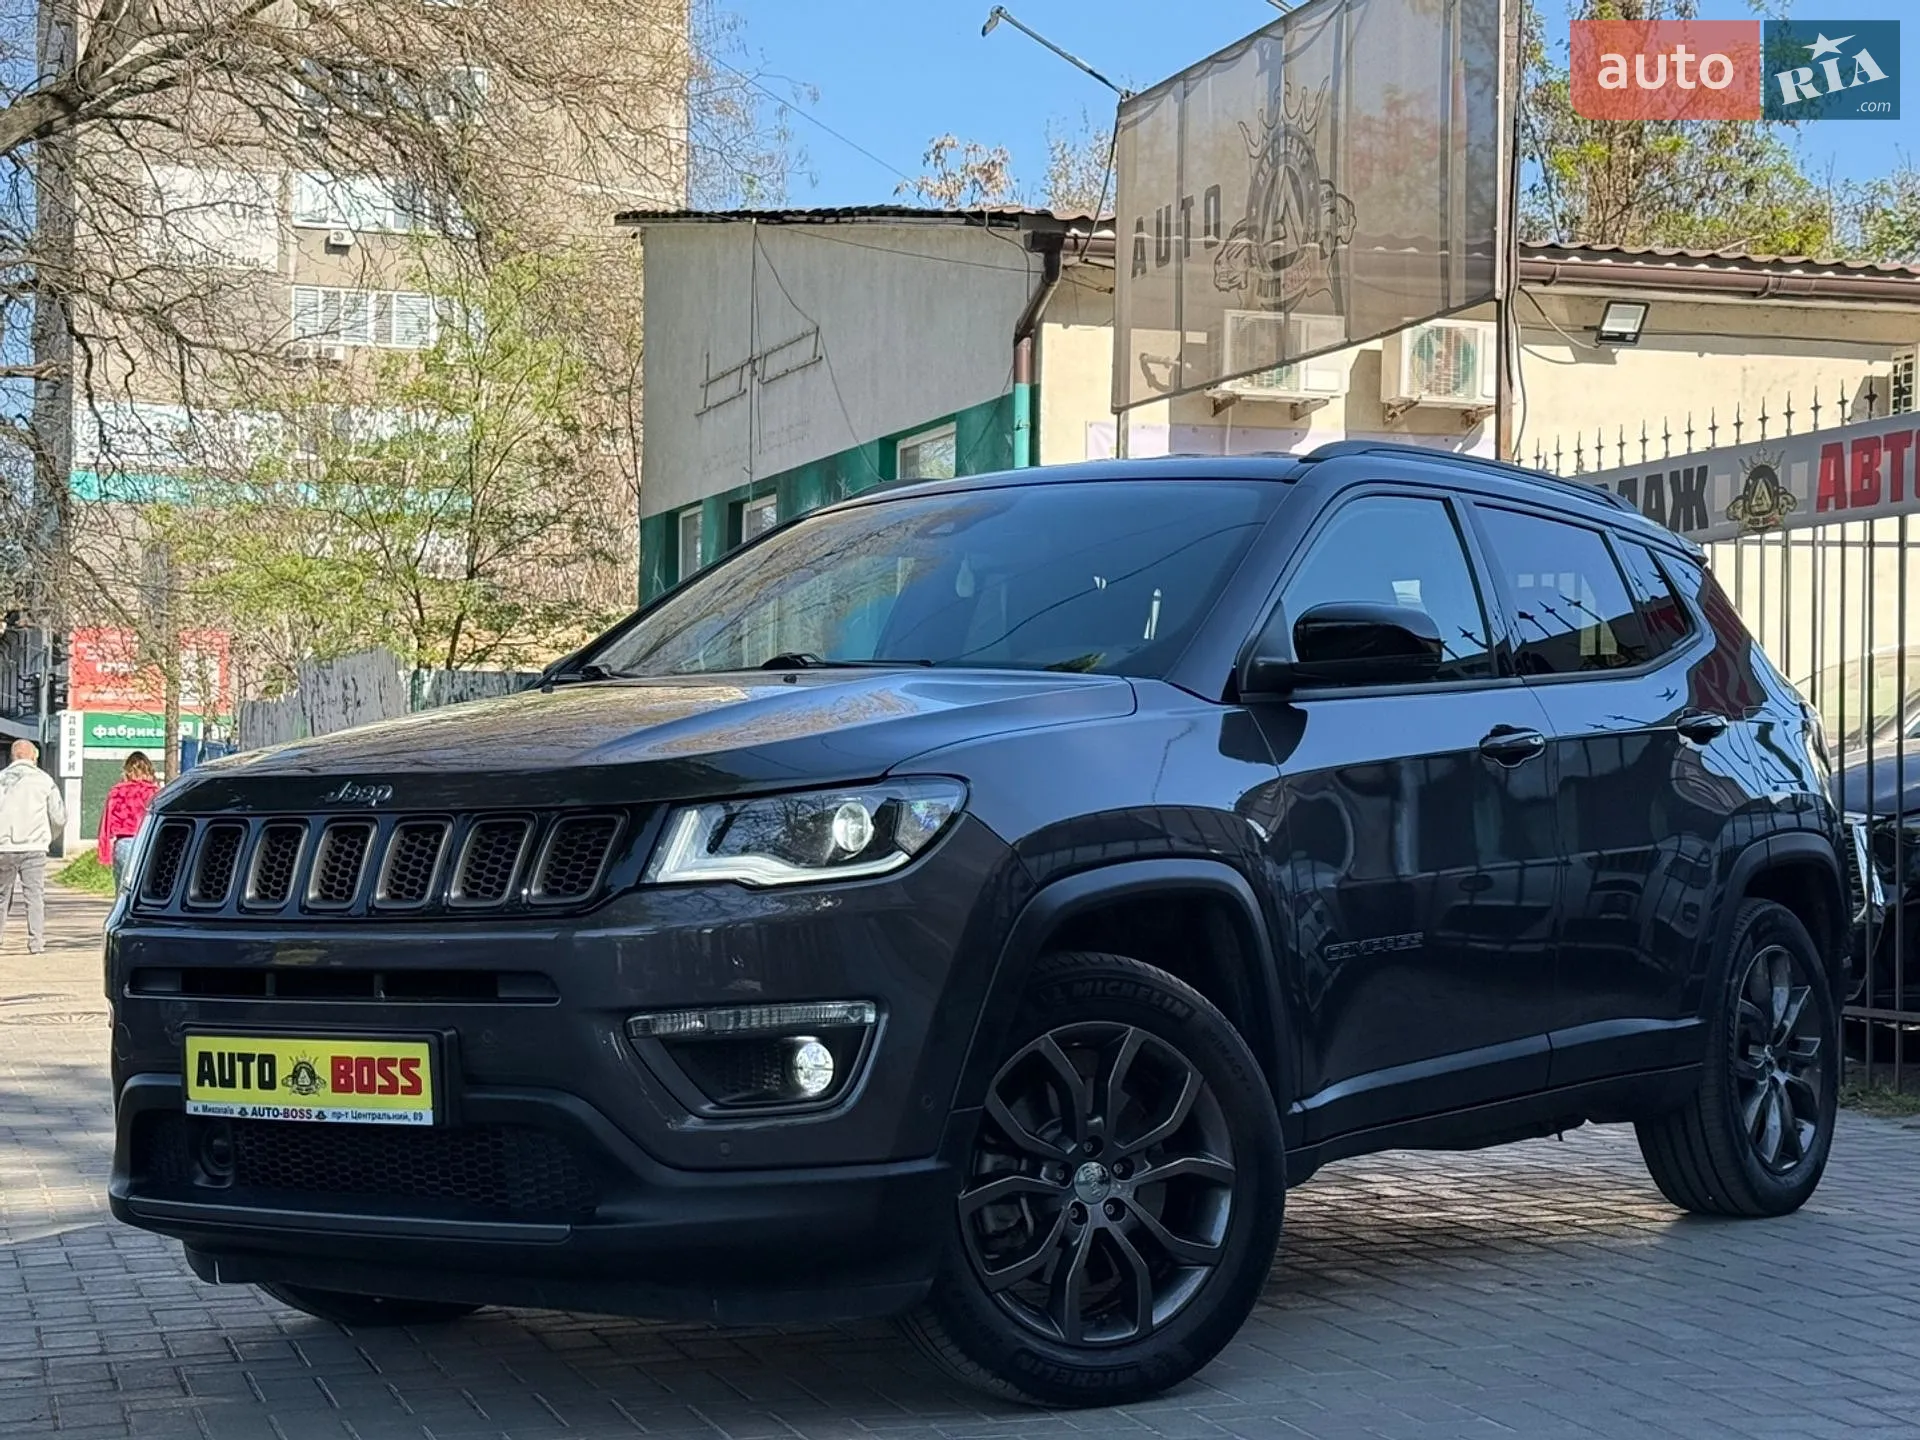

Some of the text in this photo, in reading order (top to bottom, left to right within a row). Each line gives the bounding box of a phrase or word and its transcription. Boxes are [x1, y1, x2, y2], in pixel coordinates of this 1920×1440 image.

[1131, 183, 1222, 280] AUTO
[1815, 429, 1920, 513] АВТ
[67, 715, 77, 772] ДВЕРИ
[320, 780, 393, 807] Jeep
[1071, 979, 1194, 1021] MICHELIN
[196, 1051, 423, 1096] AUTO BOSS
[250, 1106, 313, 1119] AUTO-BOSS
